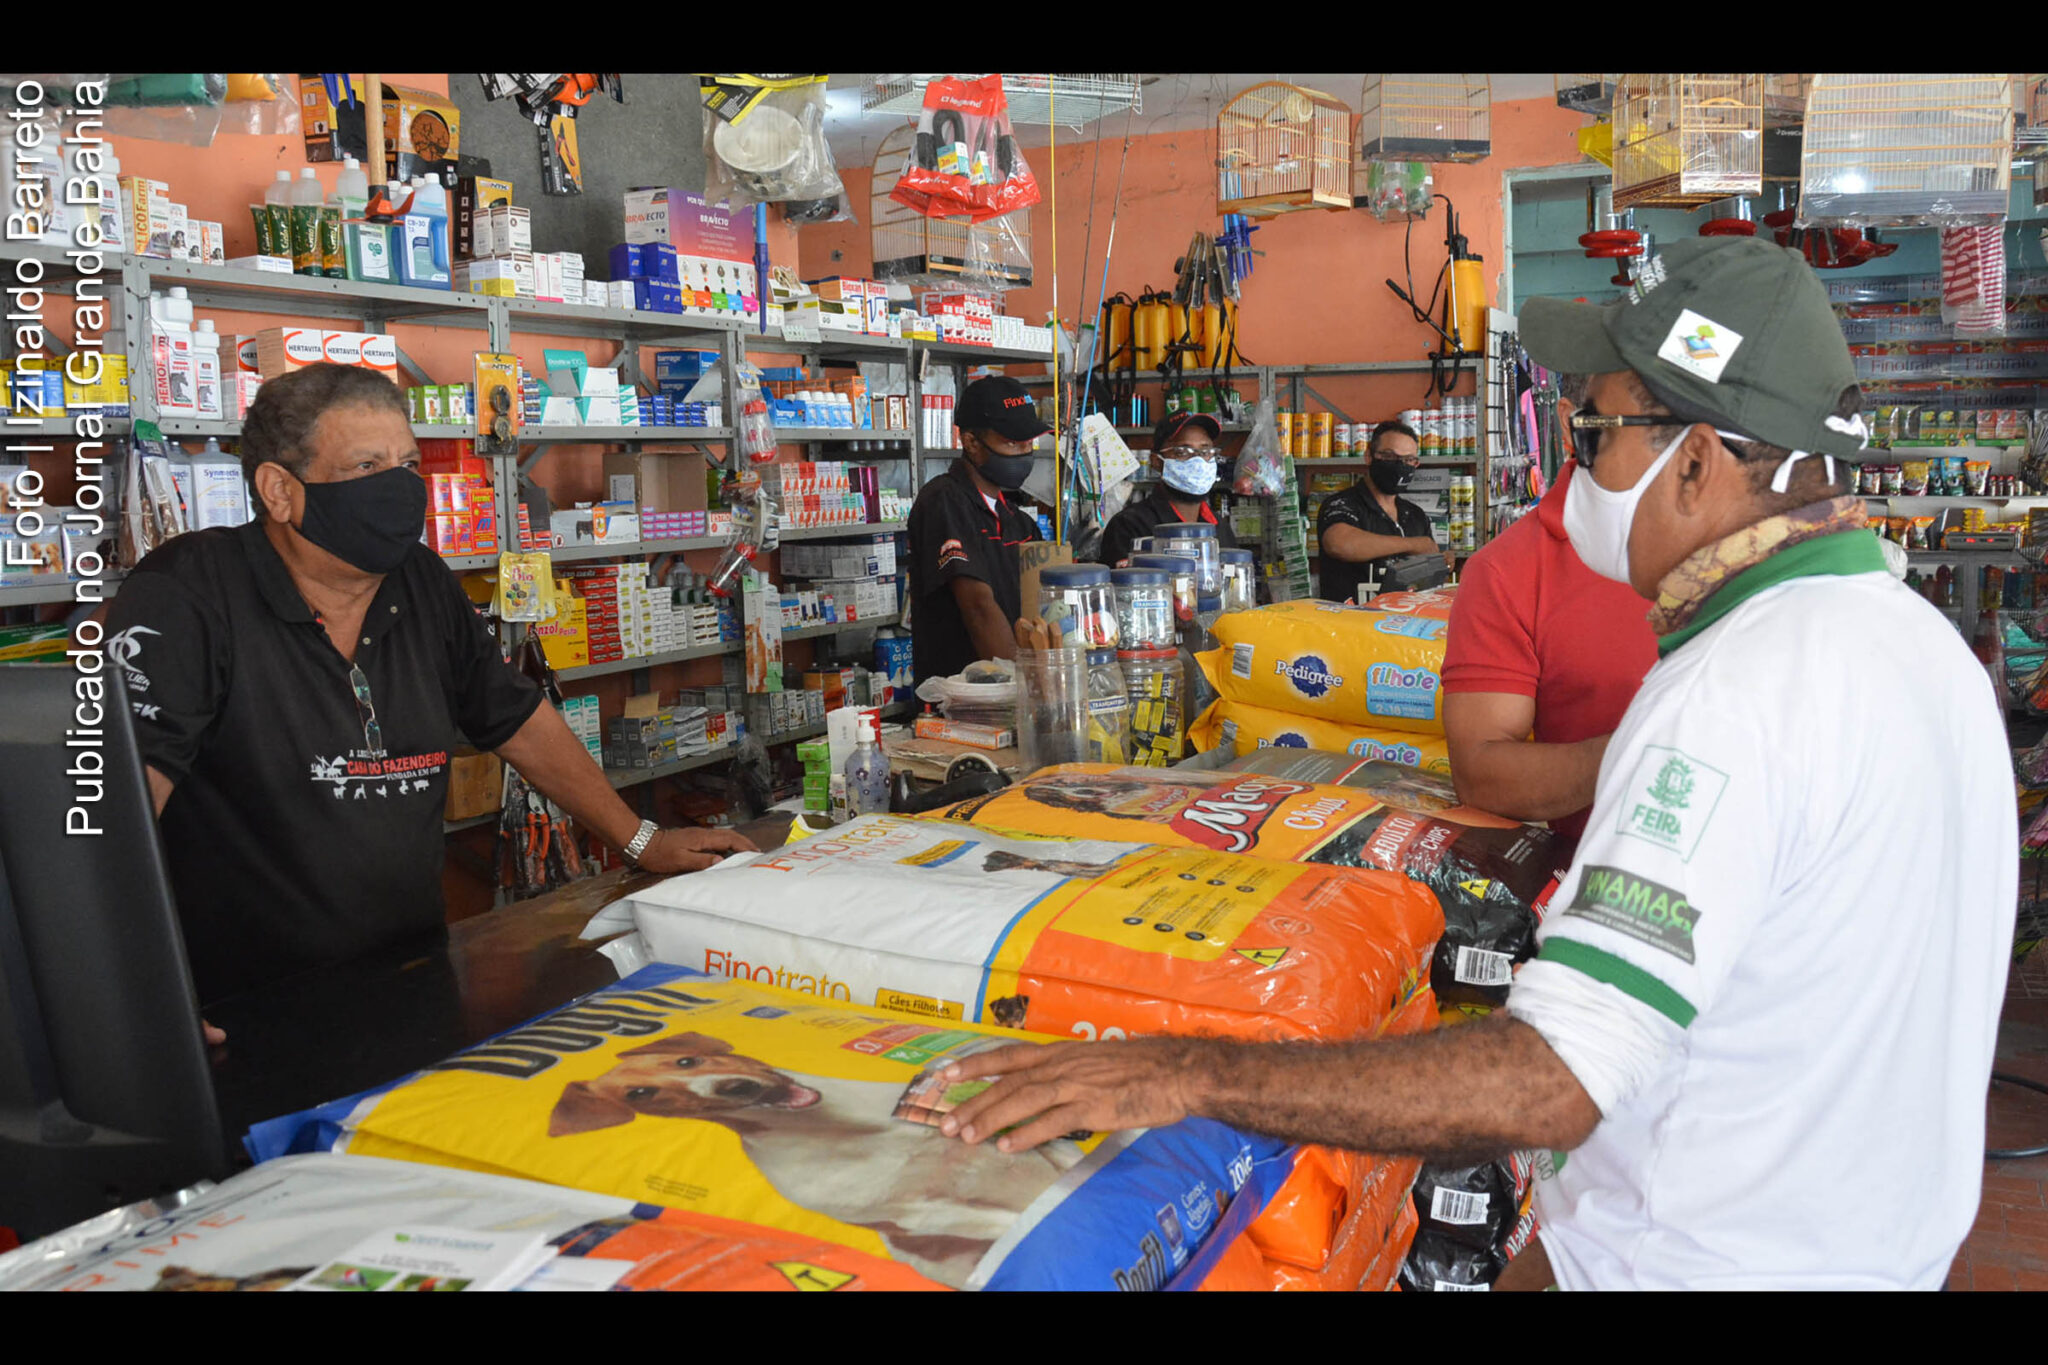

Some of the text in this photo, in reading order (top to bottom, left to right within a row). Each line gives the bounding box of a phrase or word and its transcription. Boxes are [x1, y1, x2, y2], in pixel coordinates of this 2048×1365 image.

[287, 344, 323, 354] HERTAVITA
[327, 346, 361, 356] HERTAVITA
[363, 349, 396, 359] HERTAVITA
[1274, 660, 1343, 688] Pedigree
[1371, 666, 1436, 690] filhote
[382, 751, 448, 774] FAZENDEIRO
[1283, 796, 1350, 831] Chips
[1631, 802, 1682, 835] FEIRA
[1370, 816, 1418, 871] ADULTO
[1419, 825, 1452, 851] CHIPS
[703, 947, 852, 1003] Finotrato
[887, 994, 912, 1006] Cães
